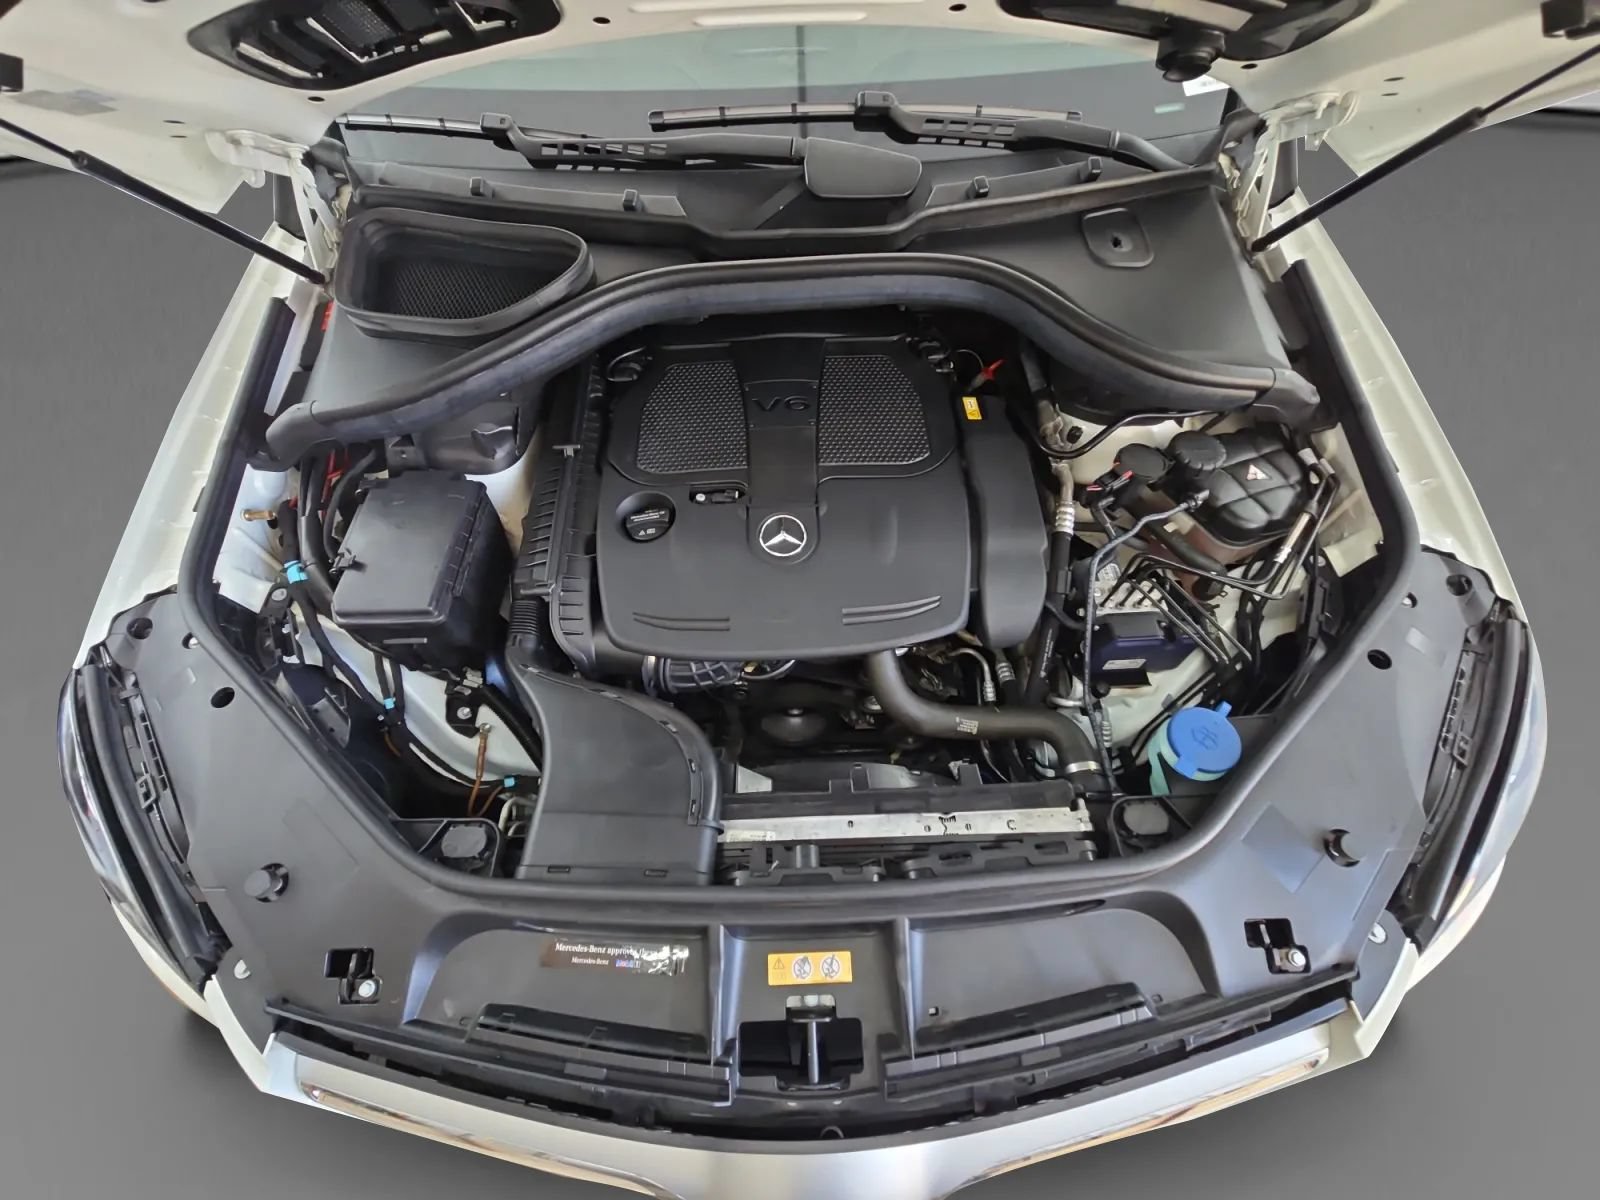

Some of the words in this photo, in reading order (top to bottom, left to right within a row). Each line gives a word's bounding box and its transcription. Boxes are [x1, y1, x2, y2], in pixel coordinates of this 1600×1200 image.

[752, 395, 811, 412] V6
[555, 943, 605, 954] Mercedes-Benz
[607, 945, 637, 958] approve
[572, 957, 609, 965] Mercedes-Benz
